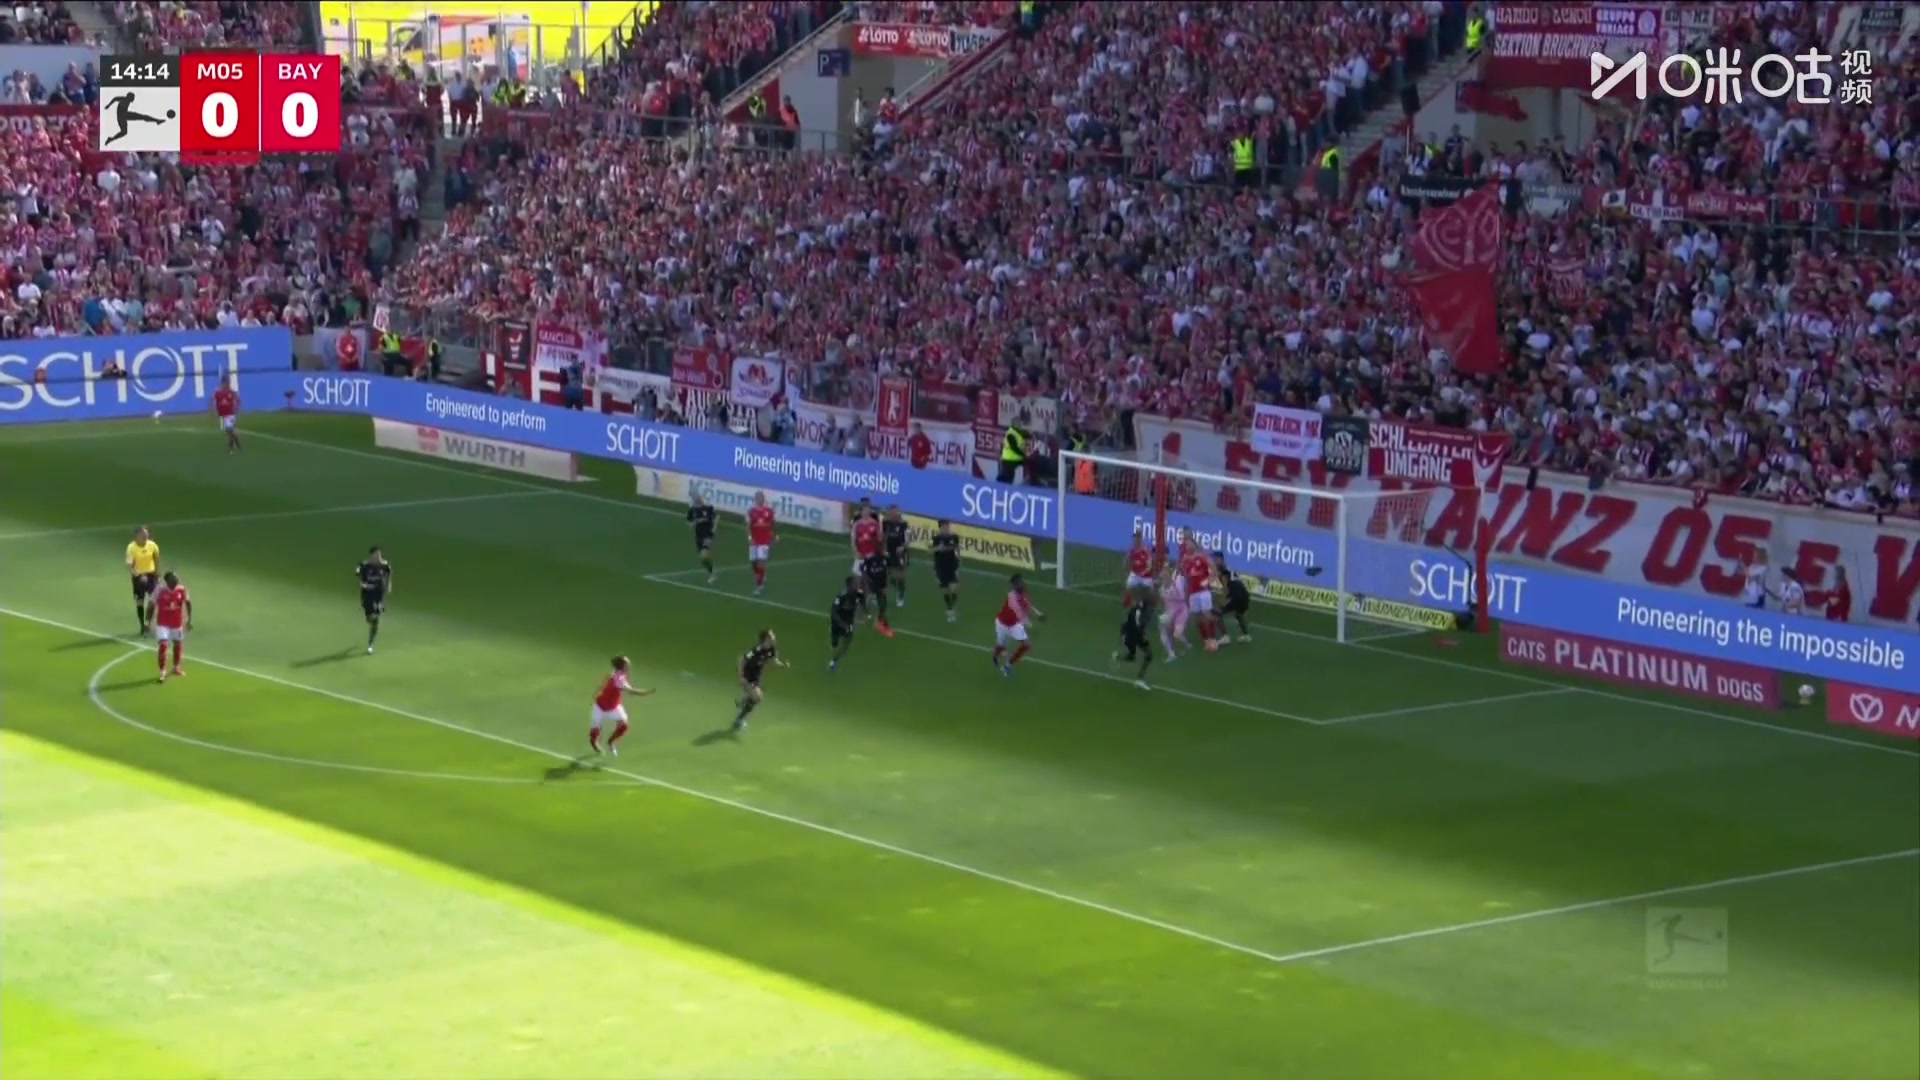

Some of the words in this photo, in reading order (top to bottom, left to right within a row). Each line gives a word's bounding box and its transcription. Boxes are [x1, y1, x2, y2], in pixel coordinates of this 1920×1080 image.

[0, 343, 248, 411] SCHOTT
[303, 377, 371, 407] SCHOTT
[426, 392, 486, 422] Engineered
[488, 407, 500, 423] to
[501, 408, 547, 433] perform
[606, 421, 680, 463] SCHOTT
[1384, 450, 1452, 481] UMGANG
[734, 446, 801, 482] Pioneering
[804, 458, 825, 482] the
[829, 460, 900, 495] impossible
[689, 479, 823, 526] Kömmling
[962, 483, 1052, 530] SCHOTT
[1226, 532, 1243, 555] to
[1246, 537, 1315, 568] perform
[1618, 596, 1731, 646] Pioneering
[1737, 618, 1773, 647] the
[1779, 624, 1905, 670] impossible
[1507, 637, 1546, 662] CATS
[1554, 638, 1709, 693] PLATINUM
[1717, 675, 1764, 703] DOGS
